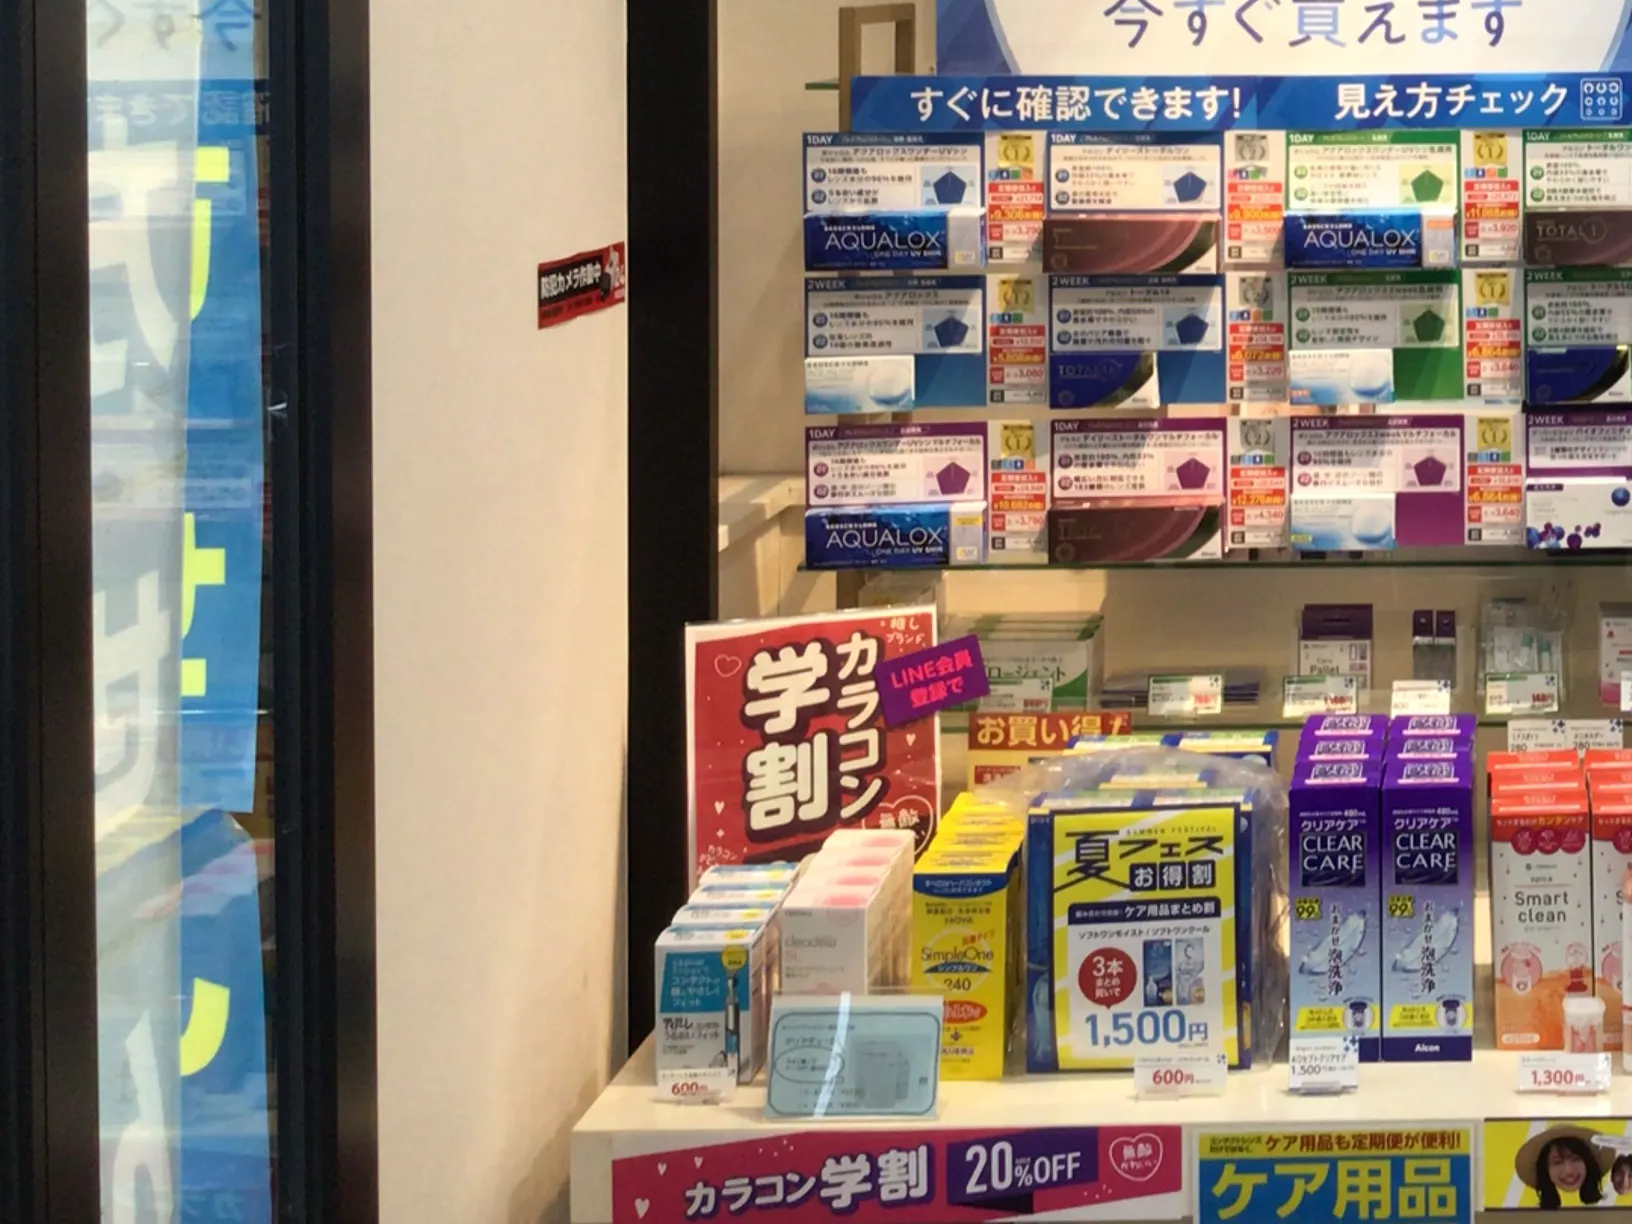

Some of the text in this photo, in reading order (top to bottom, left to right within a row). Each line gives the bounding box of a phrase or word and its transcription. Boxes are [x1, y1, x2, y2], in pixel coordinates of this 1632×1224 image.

[910, 81, 1568, 124] すぐに確認できます! 見え方チェック
[807, 135, 832, 144] 1DAY
[1051, 134, 1076, 143] 1DAY
[1289, 134, 1314, 143] 1DAY
[1526, 132, 1550, 141] 1DAY
[825, 232, 942, 251] AQUALOX
[1303, 230, 1417, 248] AQUALOX
[807, 280, 847, 289] 2WEEK
[1052, 277, 1090, 286] 2WEEK
[1054, 422, 1079, 431] 1DAY
[1293, 419, 1329, 427] 2WEEK
[1528, 415, 1564, 424] 2WEEK
[809, 429, 835, 438] 1DAY
[826, 528, 944, 549] AQUALOX
[892, 649, 972, 688] LINE会員
[837, 632, 883, 819] カラコン
[745, 642, 830, 831] 学割
[1301, 819, 1358, 832] クリアケア
[1394, 817, 1451, 829] クリアケア
[1302, 834, 1363, 853] CLEAR
[1395, 832, 1456, 851] CLEAR
[1054, 829, 1224, 893] 夏フェス
[1303, 854, 1363, 873] CARE
[1396, 852, 1456, 871] CARE
[1134, 862, 1212, 888] お得割
[1514, 892, 1569, 907] Smart
[1125, 901, 1215, 917] ケア用品まとめ割
[1518, 909, 1567, 923] clean
[1092, 955, 1124, 977] 3本
[1096, 977, 1120, 987] まとめ
[1085, 1008, 1209, 1049] 1,500円
[1414, 1042, 1440, 1053] Alcon
[1152, 1069, 1194, 1086] 600円
[1265, 1127, 1461, 1153] ケア用品も定期便が便利!
[684, 1144, 929, 1216] カラコン学割
[1212, 1158, 1457, 1220] ケア用品
